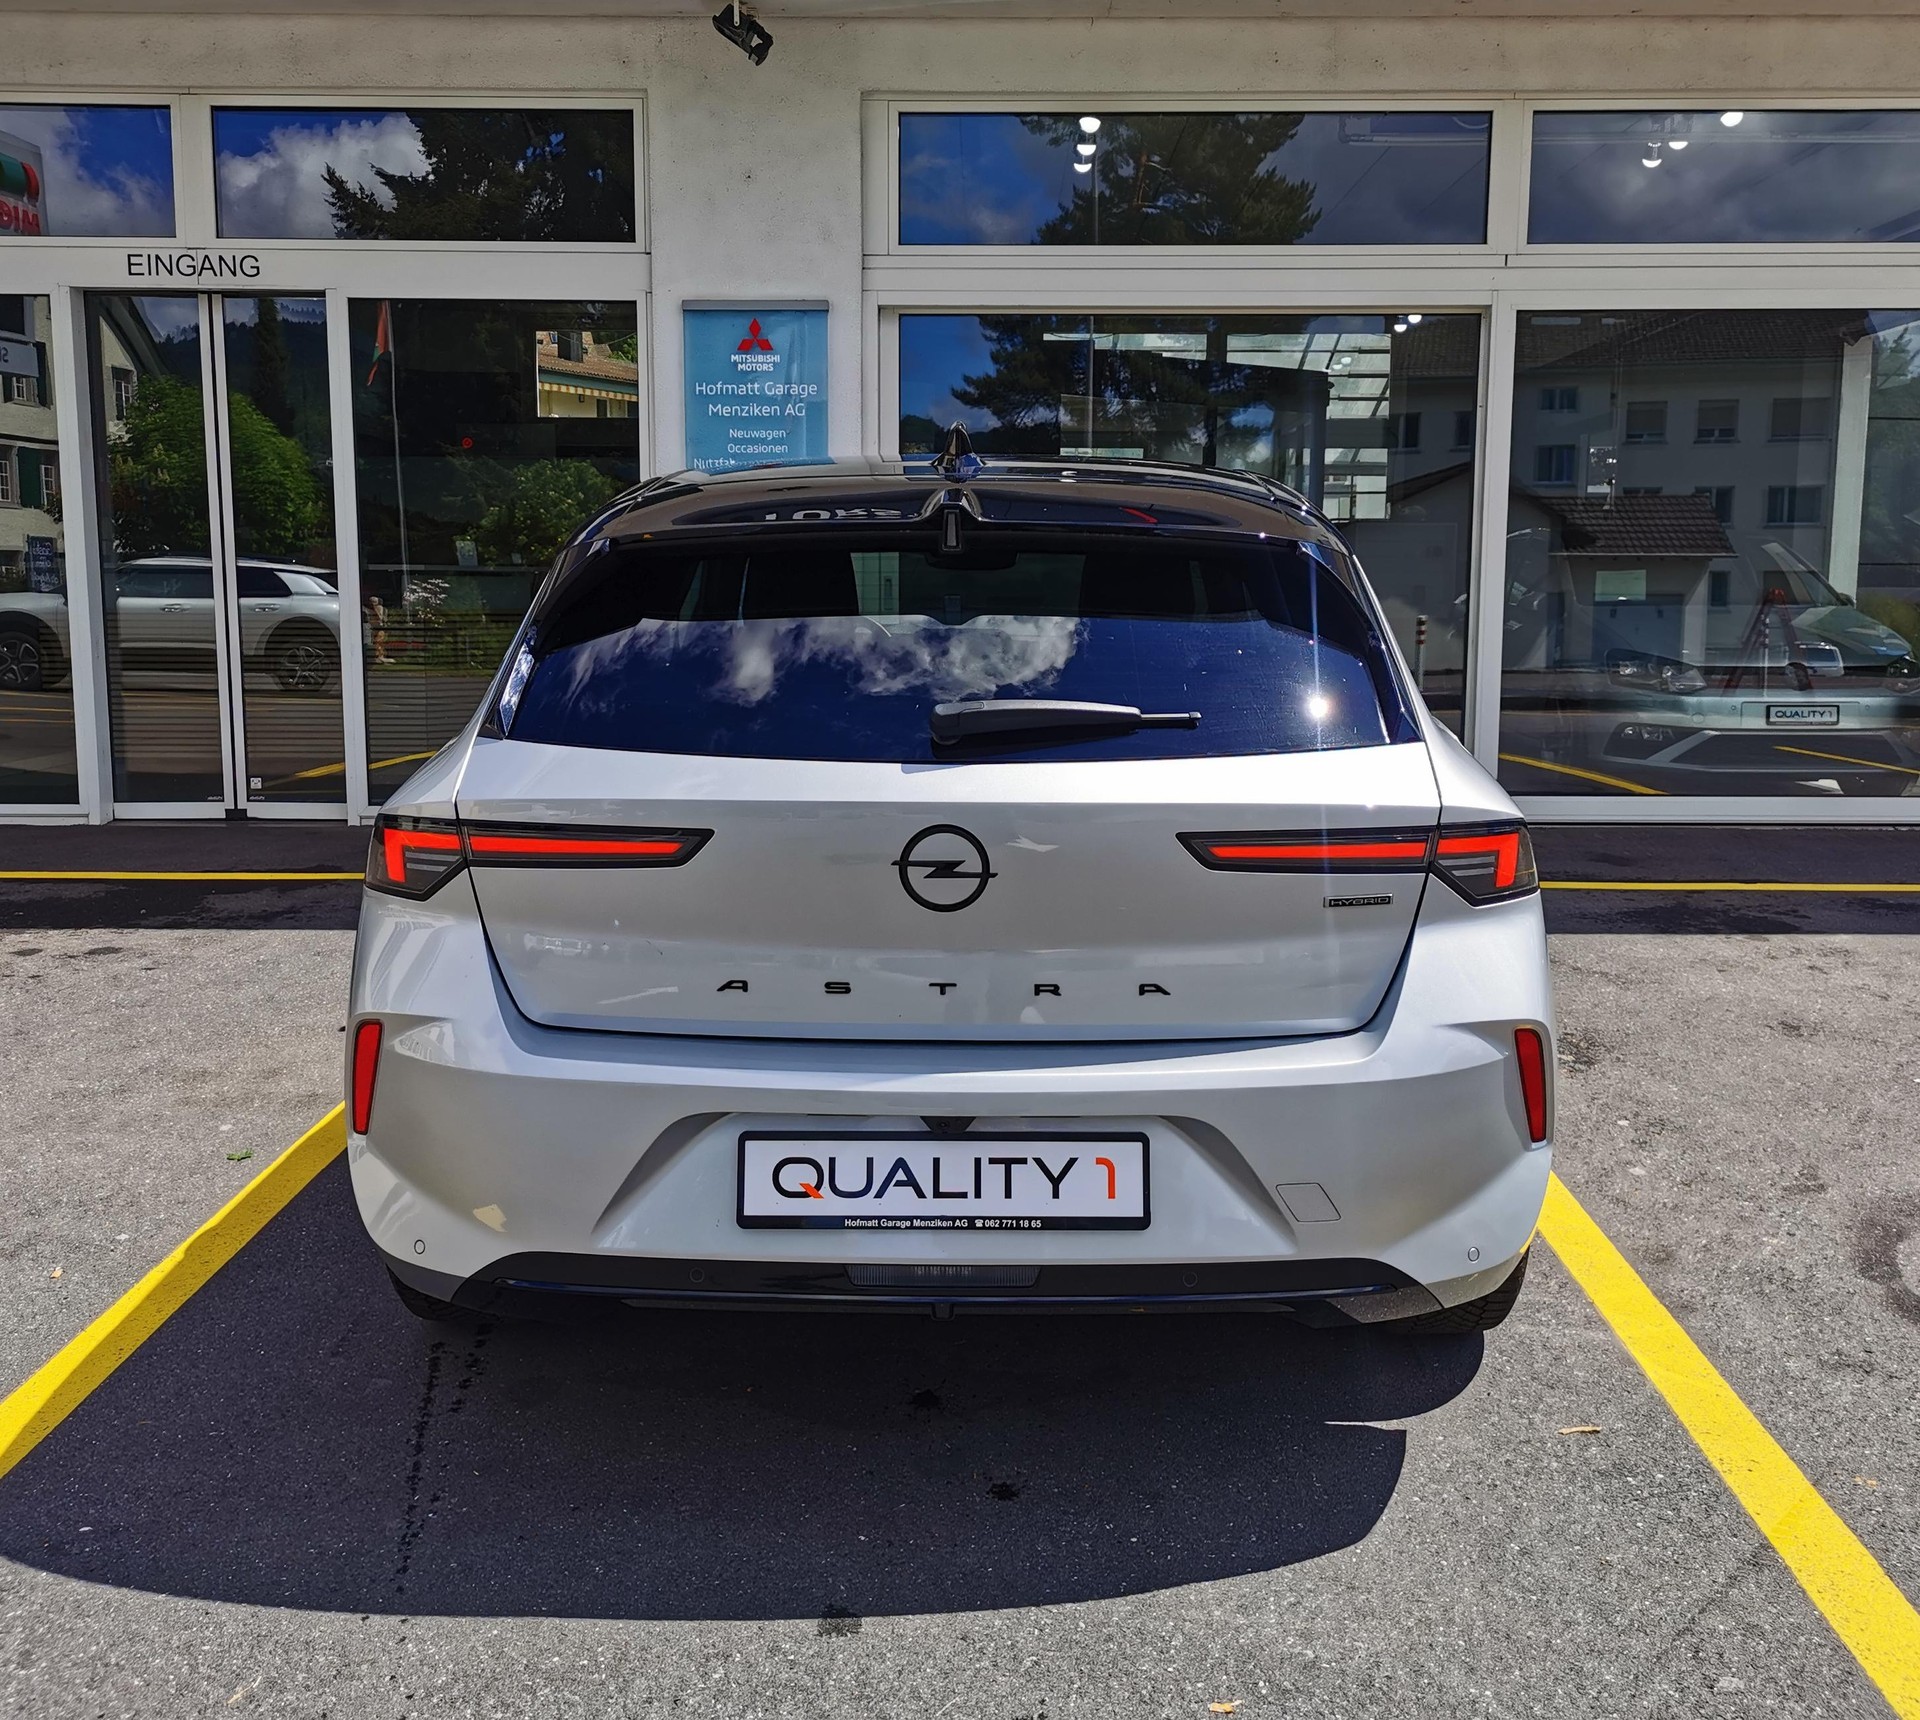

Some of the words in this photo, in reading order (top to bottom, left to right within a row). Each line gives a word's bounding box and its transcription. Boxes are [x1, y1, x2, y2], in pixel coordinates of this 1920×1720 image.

[127, 253, 261, 278] EINGANG
[730, 354, 781, 363] MITSUBISHI
[737, 363, 774, 372] MOTORS
[695, 381, 760, 396] Hofmatt
[764, 382, 818, 398] Garage
[708, 403, 781, 417] Menziken
[784, 403, 806, 417] AG
[729, 429, 787, 441] Neuwagen
[727, 443, 789, 454] Occasionen
[1331, 897, 1389, 906] HYBRID
[716, 979, 1171, 997] ASTRA
[771, 1156, 1079, 1200] QUALITY
[1095, 1156, 1116, 1200] 1
[844, 1218, 879, 1227] Hofmatt
[880, 1218, 911, 1229] Garage
[913, 1218, 953, 1227] Menziken
[954, 1219, 969, 1227] AG
[984, 1219, 1000, 1227] 062
[1002, 1219, 1017, 1228] 771
[1019, 1219, 1029, 1228] 18
[1031, 1219, 1042, 1228] 65
